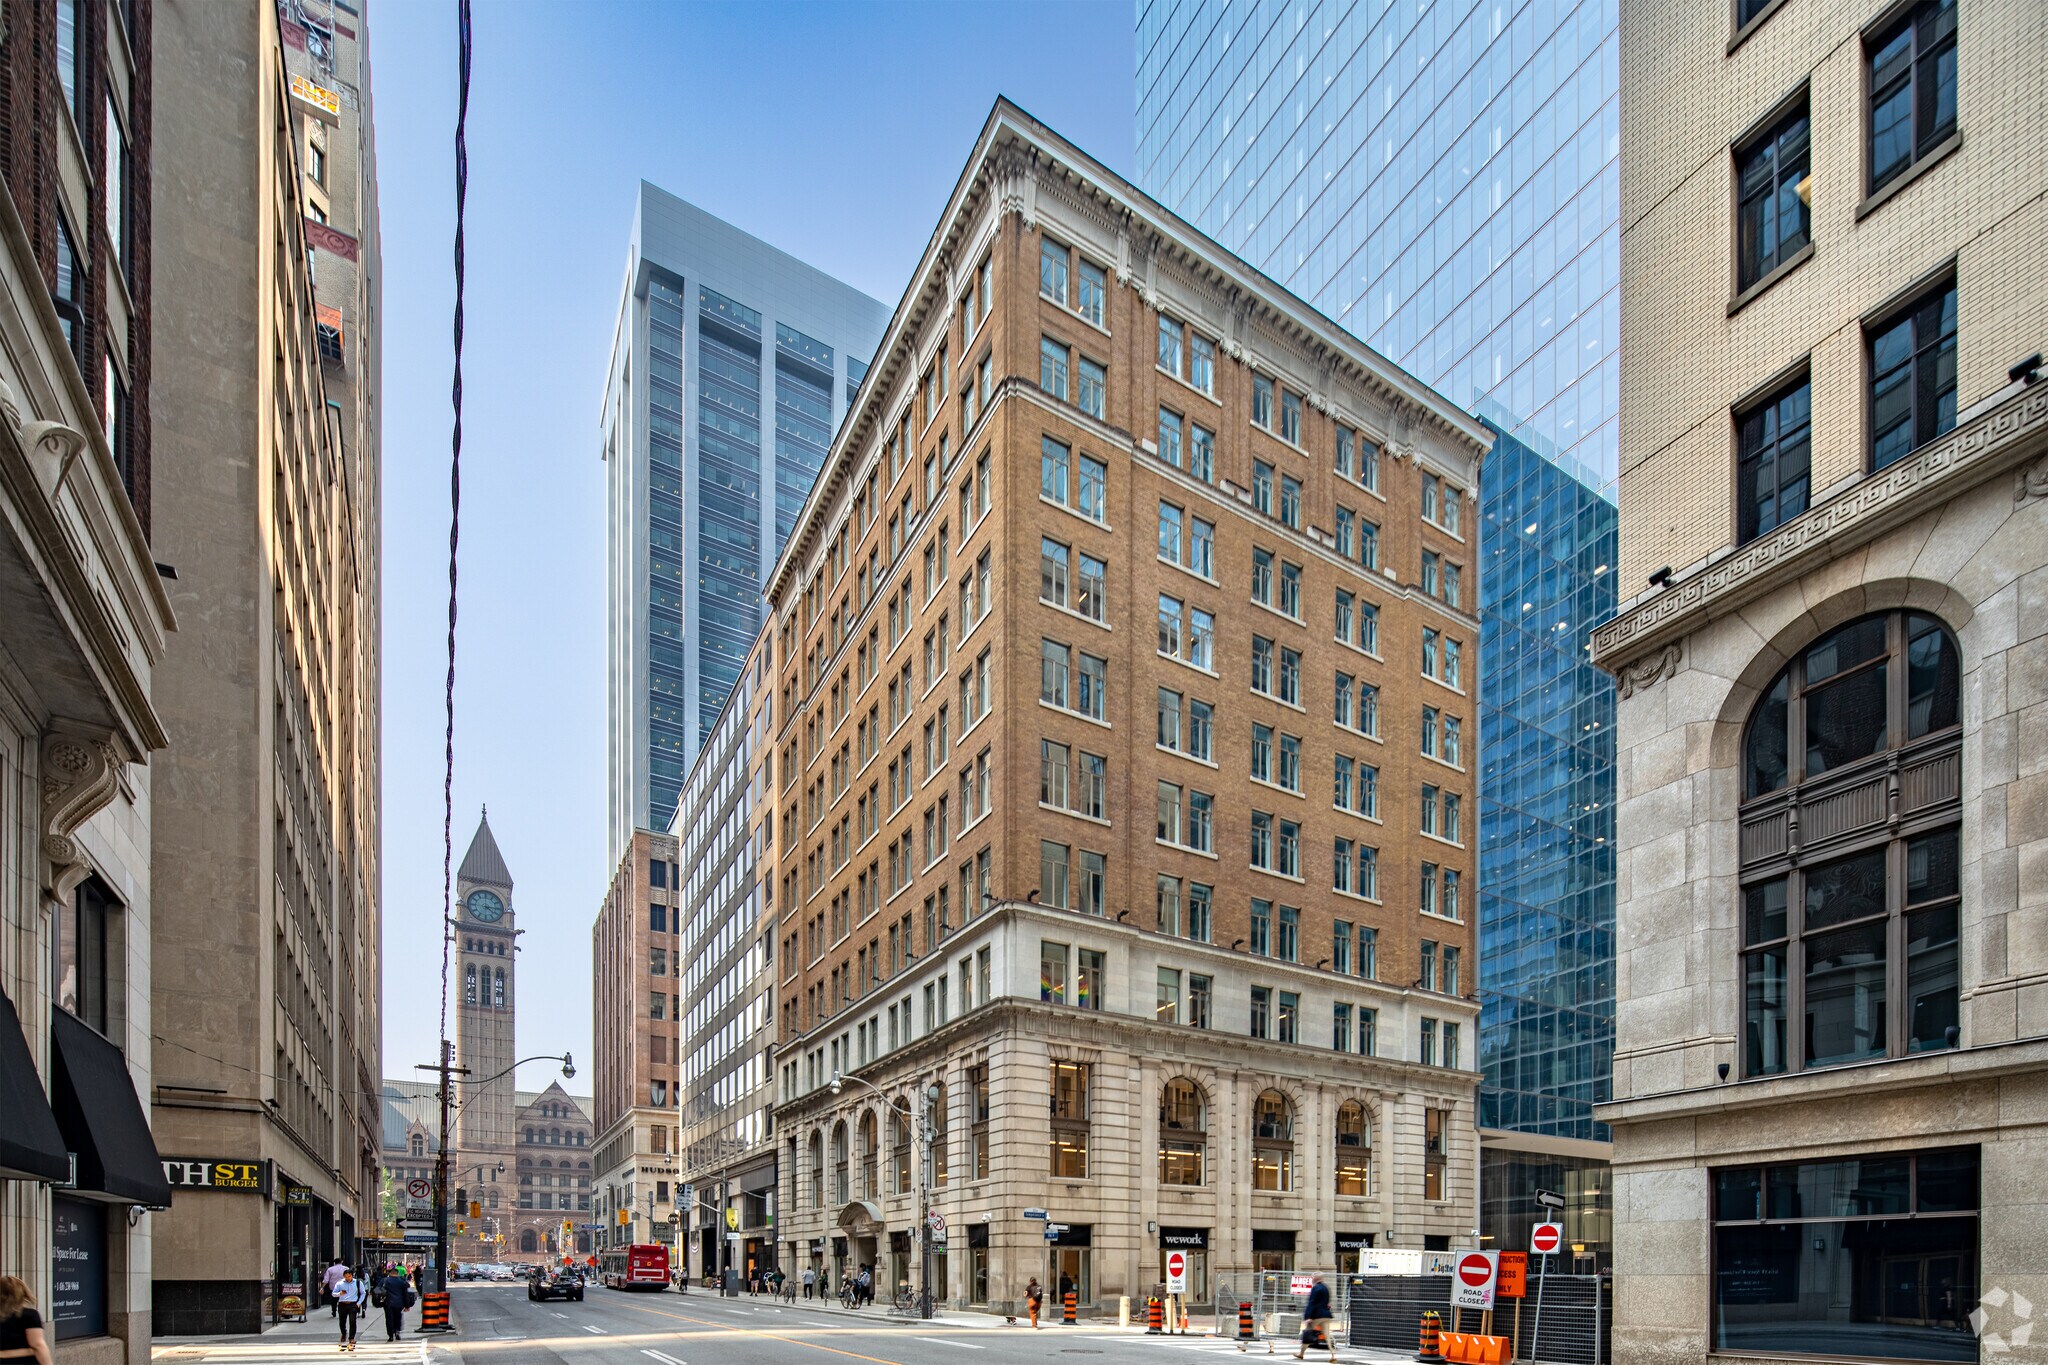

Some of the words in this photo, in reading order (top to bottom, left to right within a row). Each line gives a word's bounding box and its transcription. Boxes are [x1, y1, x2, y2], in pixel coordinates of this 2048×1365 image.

[215, 1163, 258, 1181] ST.
[215, 1179, 258, 1188] BURGER
[1165, 1233, 1202, 1244] wework
[1339, 1239, 1369, 1248] wework
[57, 1246, 69, 1261] Space
[77, 1248, 88, 1260] Lease
[1463, 1288, 1482, 1296] ROAD
[1458, 1296, 1486, 1305] CLOSED
